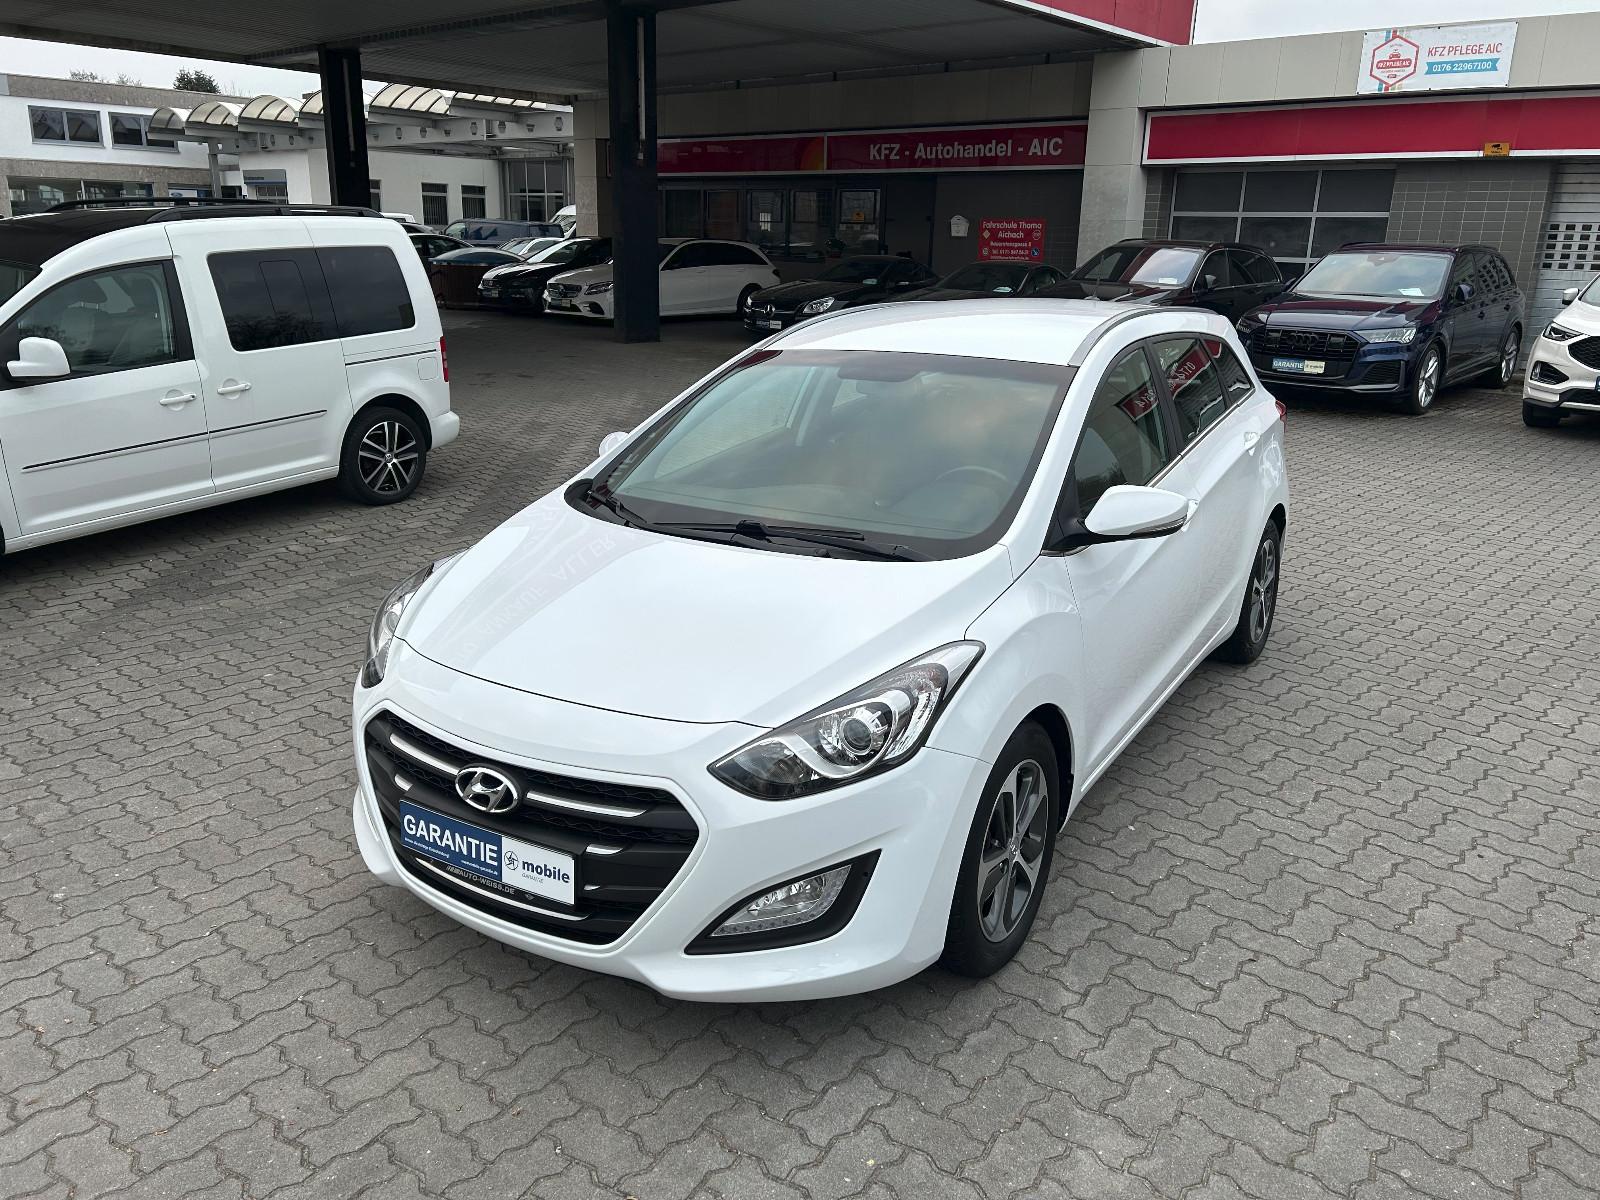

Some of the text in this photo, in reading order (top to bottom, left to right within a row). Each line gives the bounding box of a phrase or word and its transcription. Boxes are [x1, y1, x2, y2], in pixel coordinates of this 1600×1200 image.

[1428, 42, 1503, 57] KFZ PFLEGE AIC
[1432, 61, 1492, 72] 0176 22967100
[869, 143, 900, 160] KFZ
[914, 139, 1012, 159] Autohandel
[1028, 137, 1063, 156] AIC
[982, 221, 1042, 229] Fahrschule Thoma
[1273, 361, 1304, 369] GARANTIE
[403, 814, 498, 867] GARANTIE
[522, 859, 571, 884] mobile
